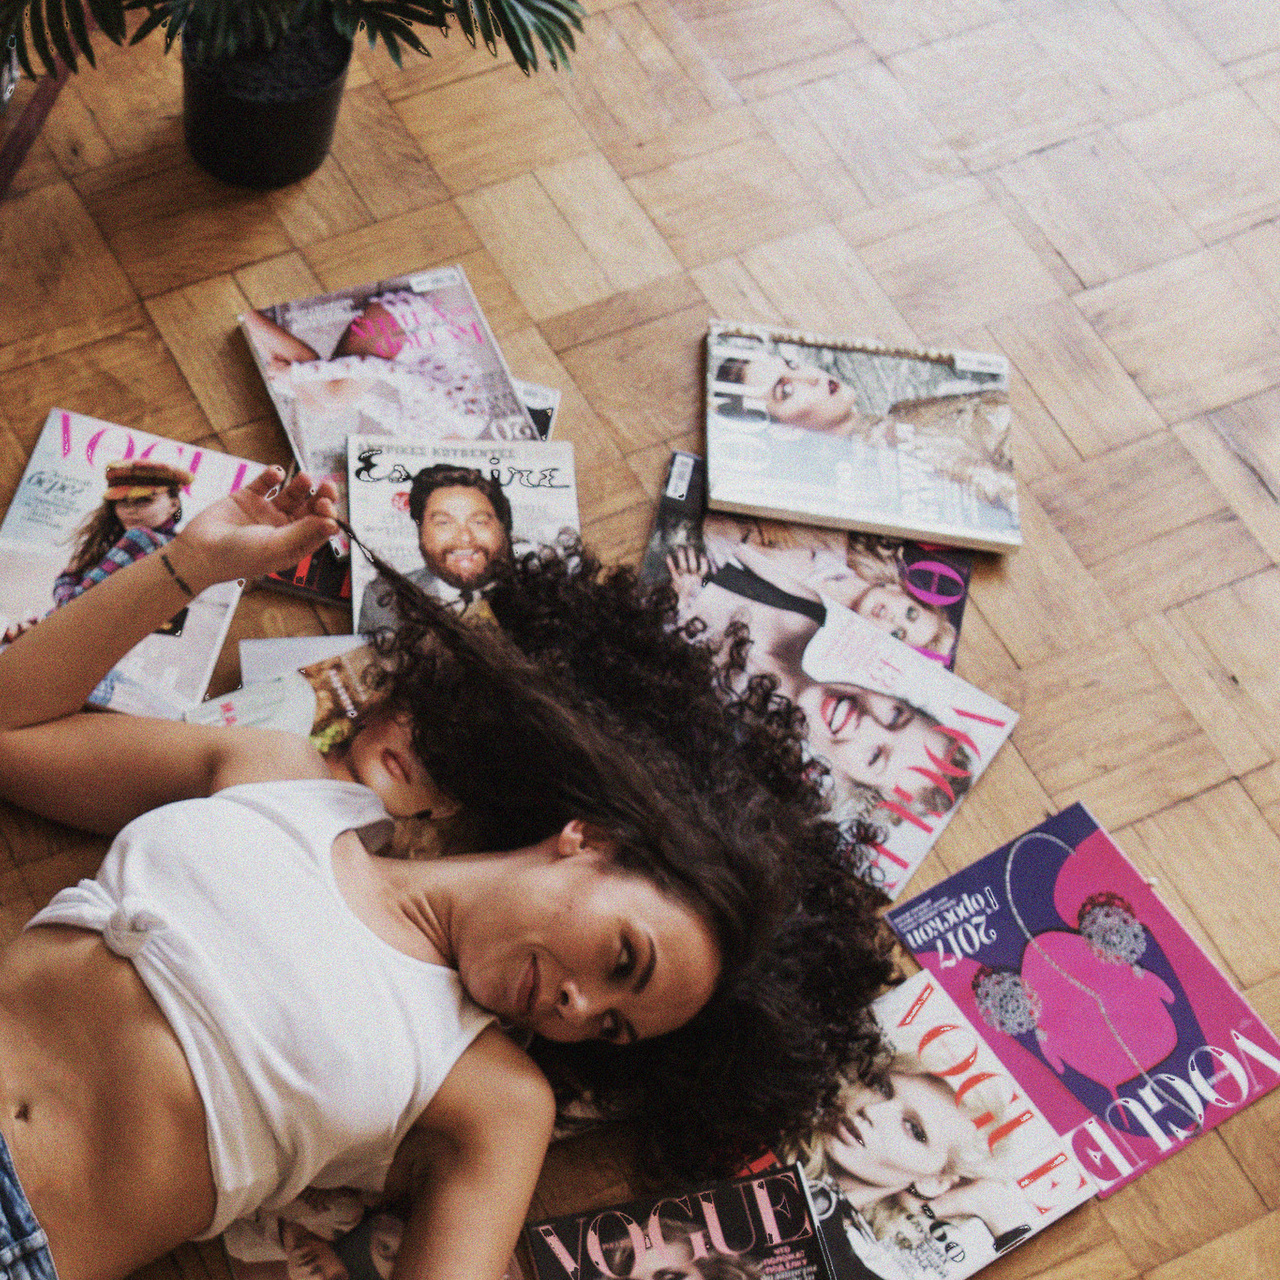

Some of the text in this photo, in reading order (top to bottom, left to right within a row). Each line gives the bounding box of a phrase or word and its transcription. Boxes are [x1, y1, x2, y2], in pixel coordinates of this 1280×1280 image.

[905, 886, 998, 949] Гороскоп
[938, 928, 998, 969] 2017
[897, 982, 1088, 1216] VOGUE
[1074, 1029, 1280, 1194] VOGUE
